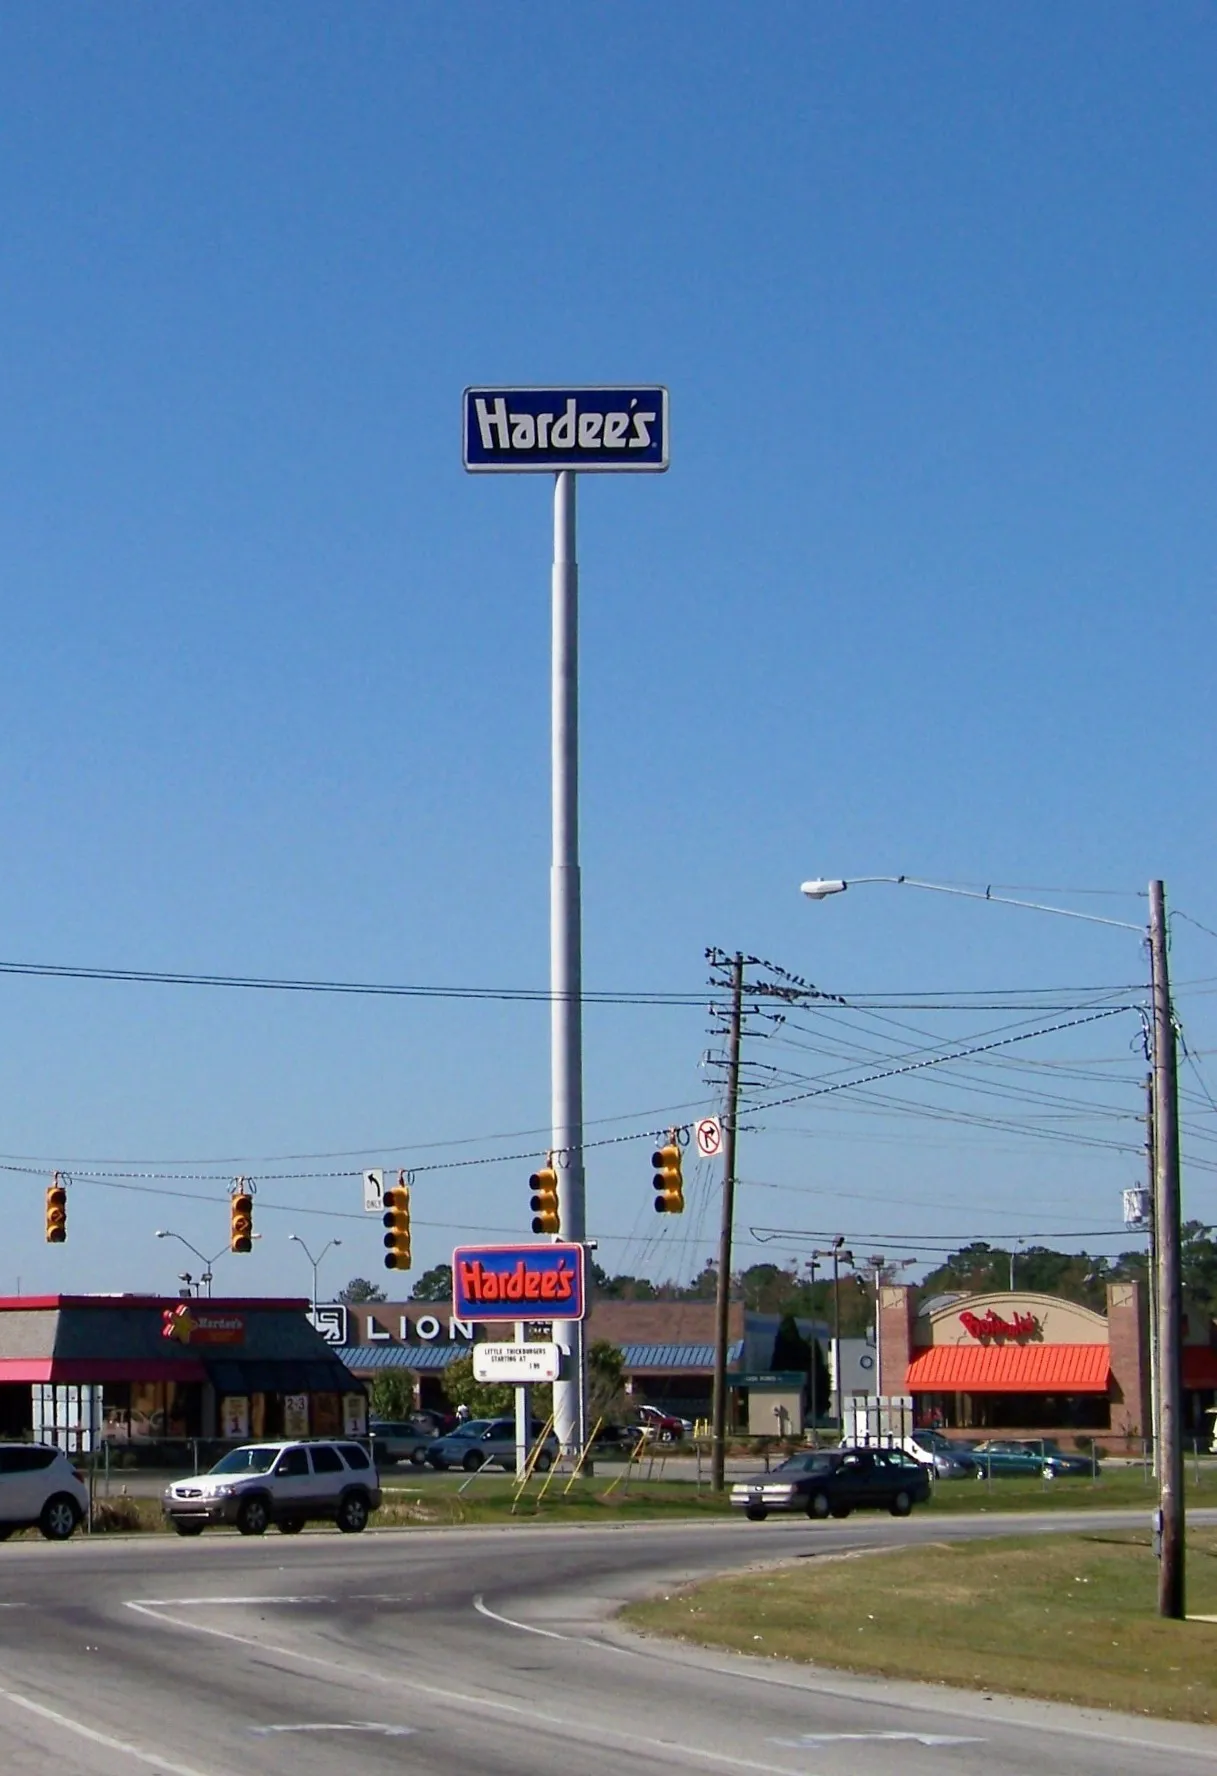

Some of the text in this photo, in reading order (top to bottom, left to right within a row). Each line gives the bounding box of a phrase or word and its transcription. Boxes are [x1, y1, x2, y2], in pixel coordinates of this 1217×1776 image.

[475, 398, 656, 449] Hardee's
[459, 1259, 575, 1301] Hardee's
[366, 1315, 474, 1340] LION
